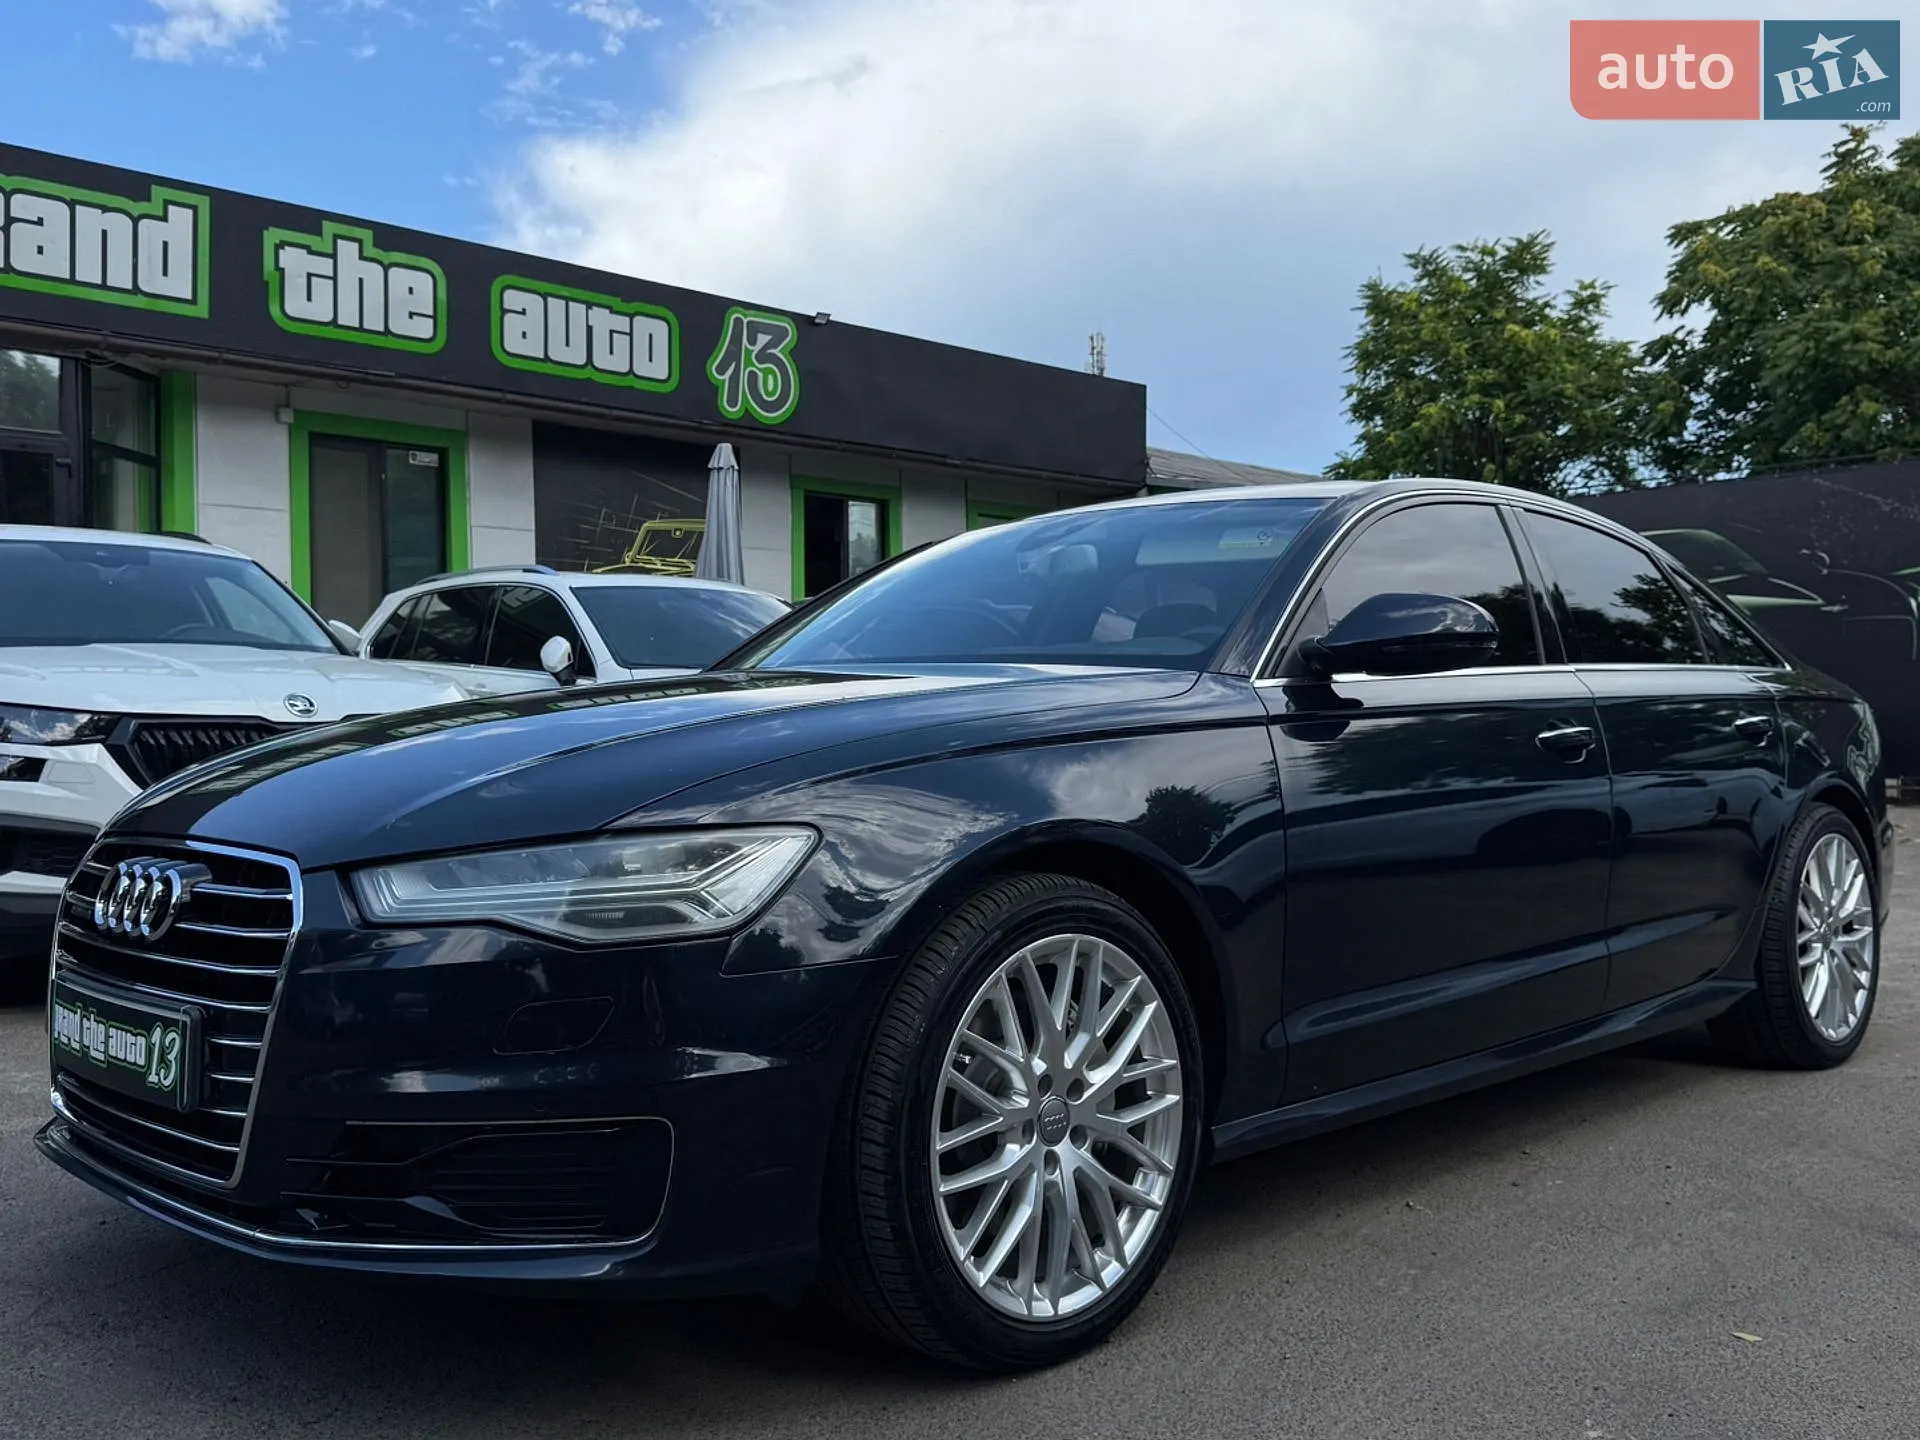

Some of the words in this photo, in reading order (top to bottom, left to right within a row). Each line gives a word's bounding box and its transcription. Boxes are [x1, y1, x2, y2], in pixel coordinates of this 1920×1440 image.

[0, 192, 194, 300] and
[279, 238, 435, 340] the
[502, 288, 669, 381] auto
[712, 313, 796, 416] 13
[108, 1027, 147, 1067] auto
[147, 1026, 180, 1087] 13
